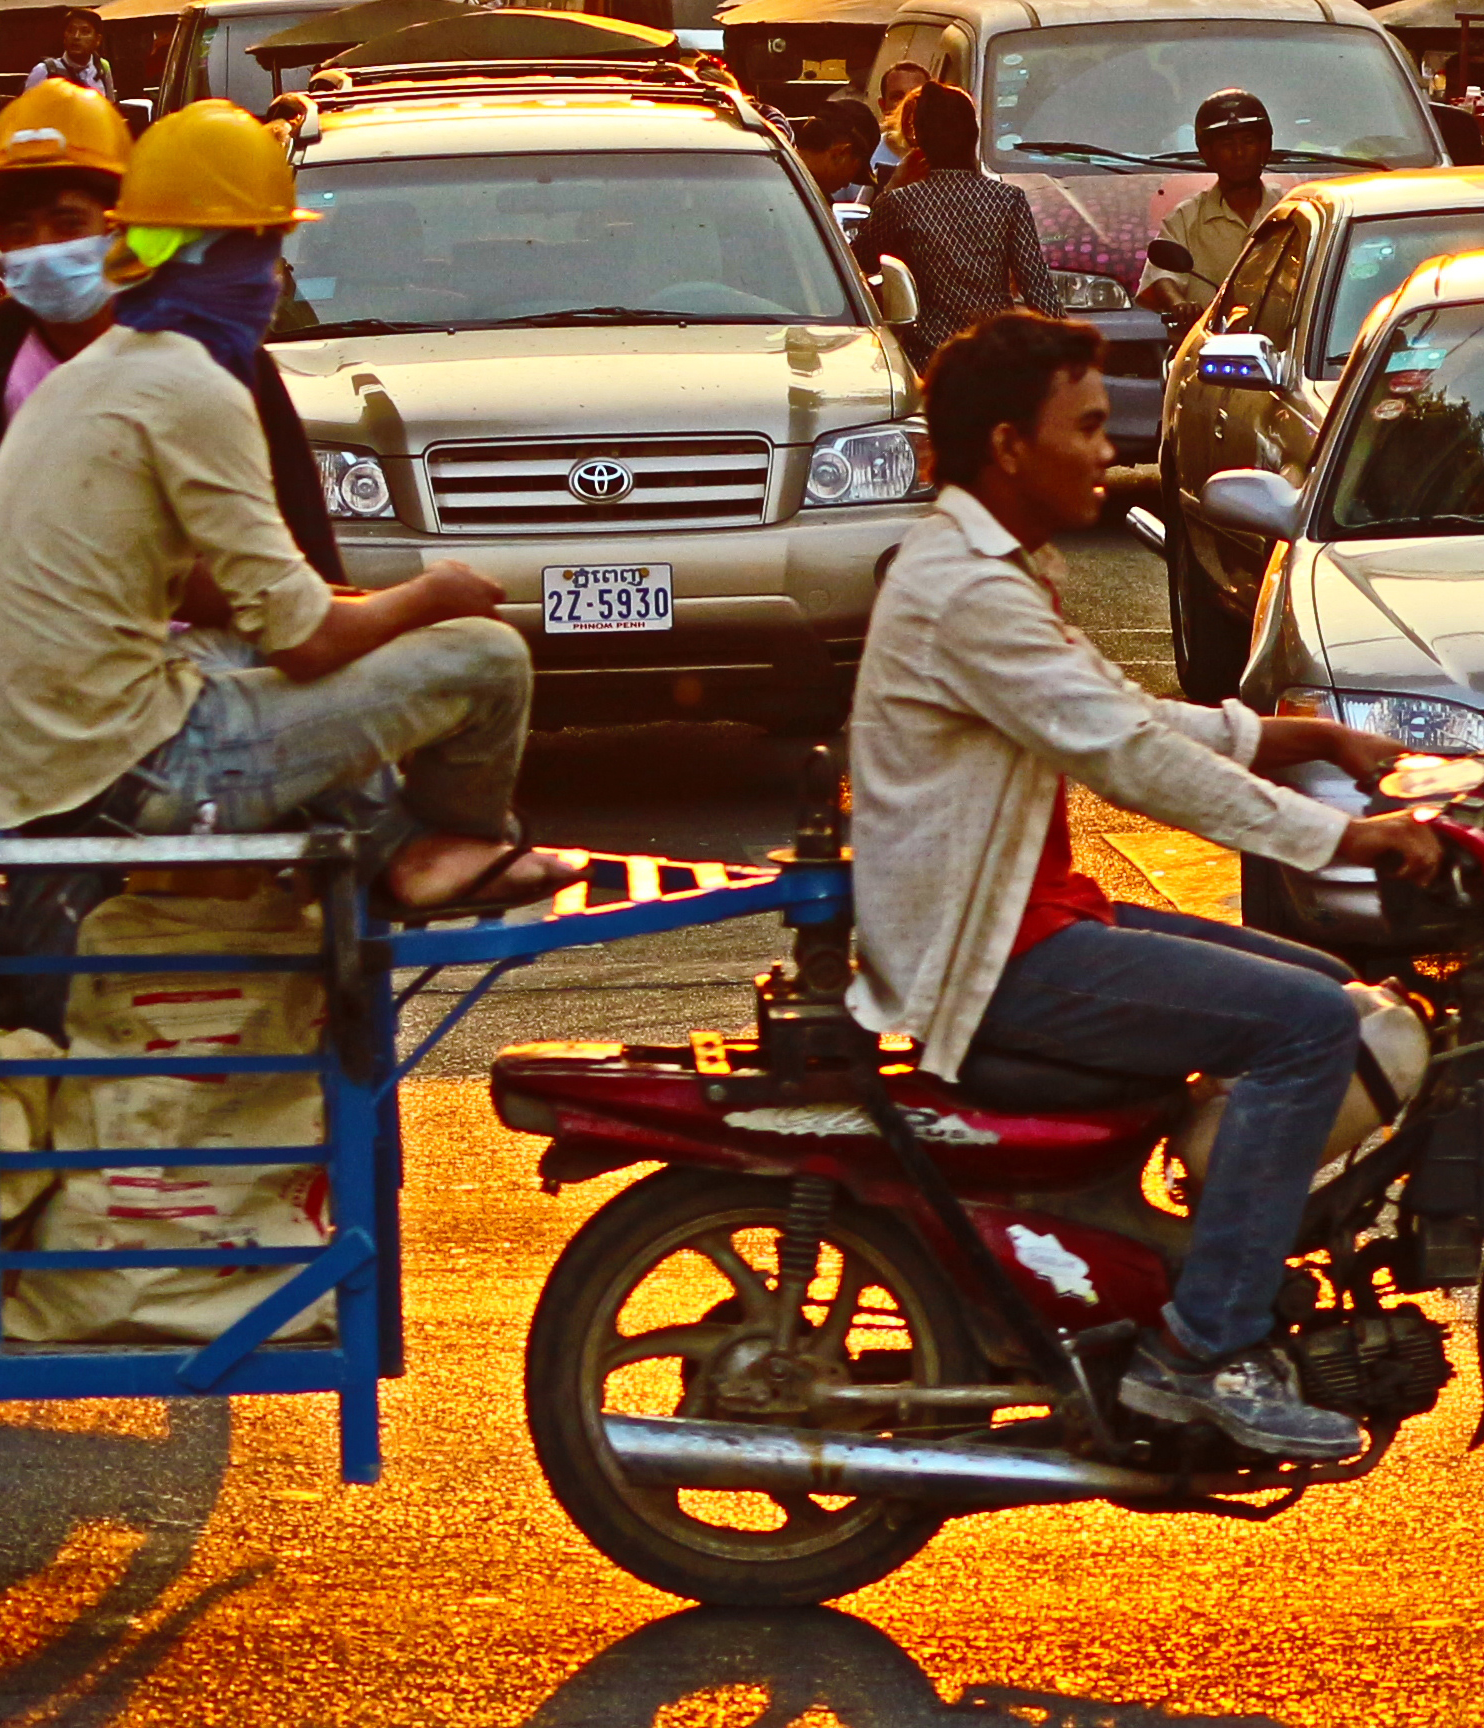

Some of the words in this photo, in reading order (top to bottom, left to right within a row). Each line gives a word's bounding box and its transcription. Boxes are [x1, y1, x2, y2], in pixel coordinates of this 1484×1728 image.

[548, 587, 669, 621] 2Z-5930
[573, 622, 613, 630] PHNOM
[616, 621, 646, 629] PENH
